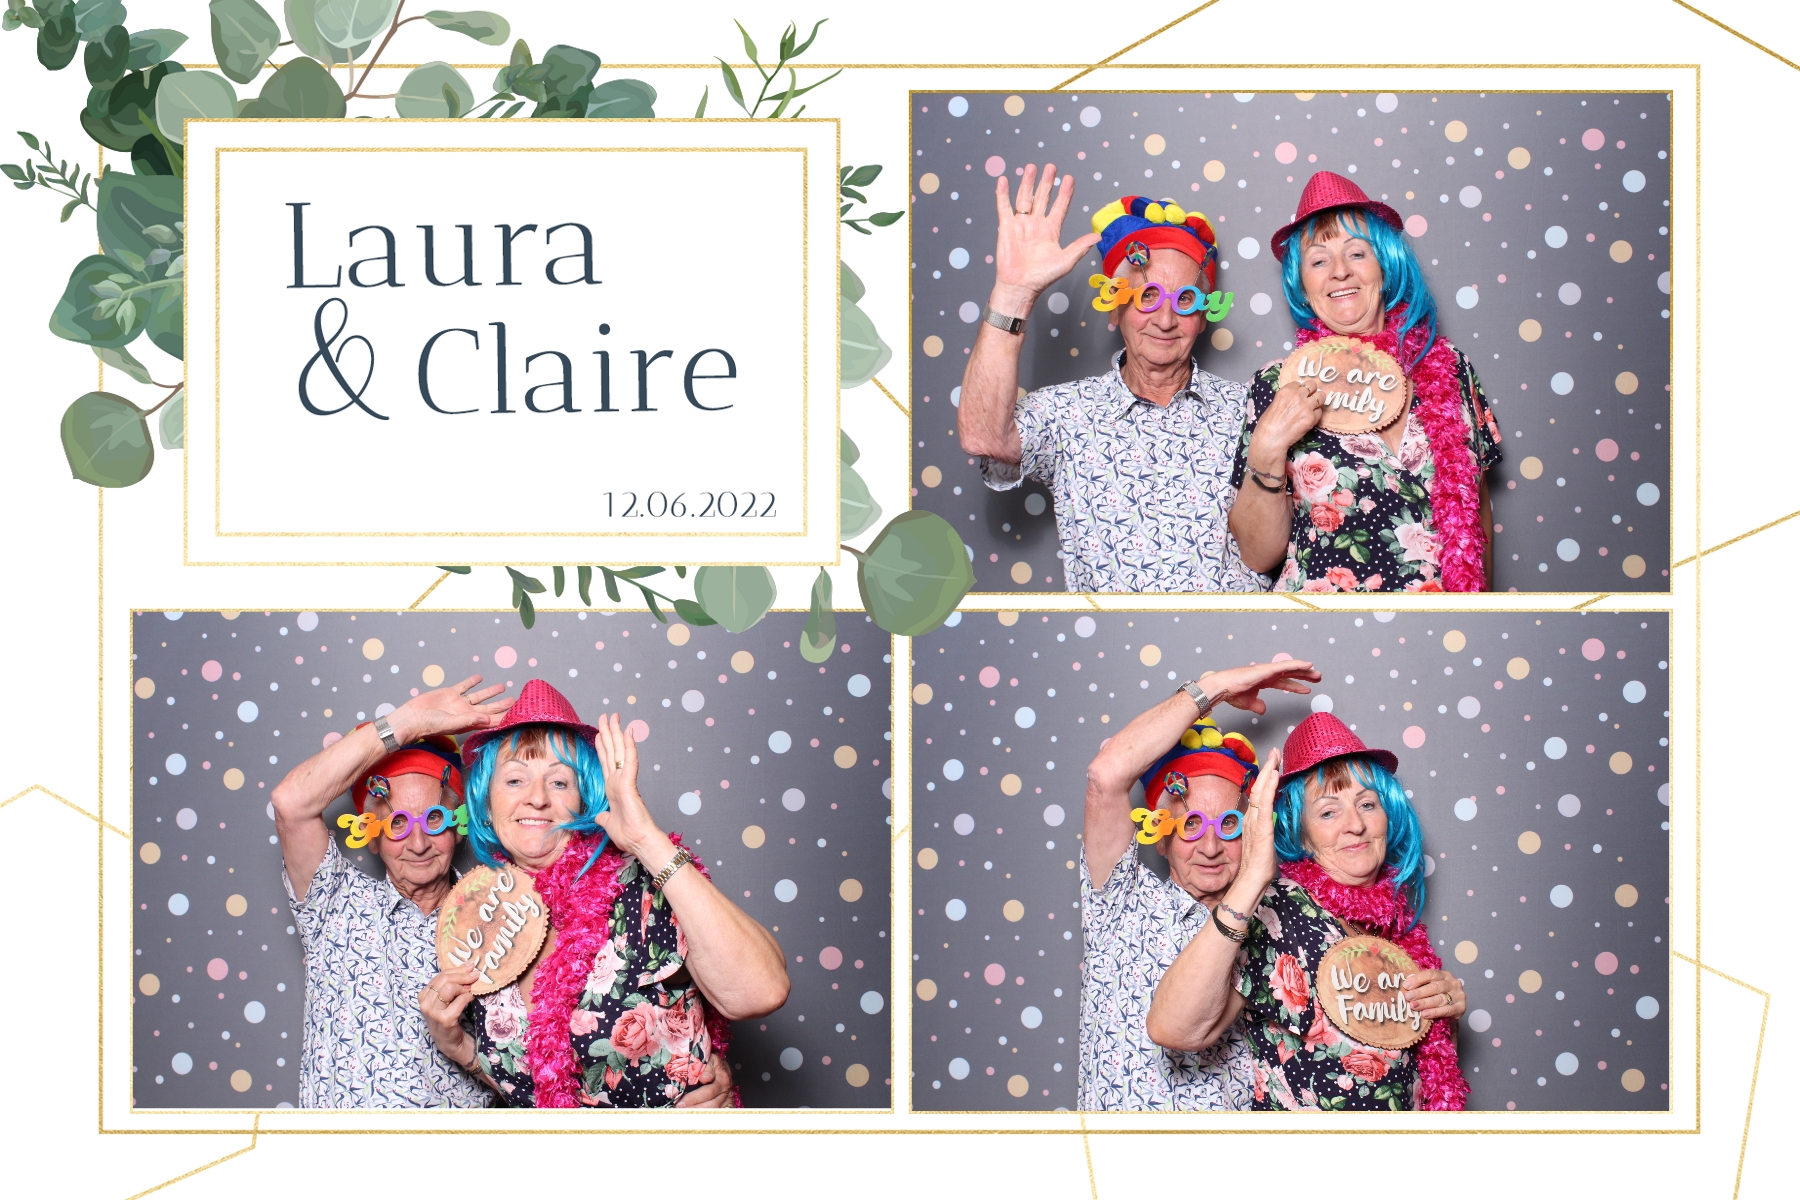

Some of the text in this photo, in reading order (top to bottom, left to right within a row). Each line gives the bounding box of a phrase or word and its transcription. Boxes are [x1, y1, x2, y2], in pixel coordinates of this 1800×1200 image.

[1297, 352, 1400, 391] We are
[1299, 380, 1387, 423] mily
[1130, 807, 1277, 845] Groo
[447, 870, 514, 967] We are
[1331, 959, 1416, 993] We ar
